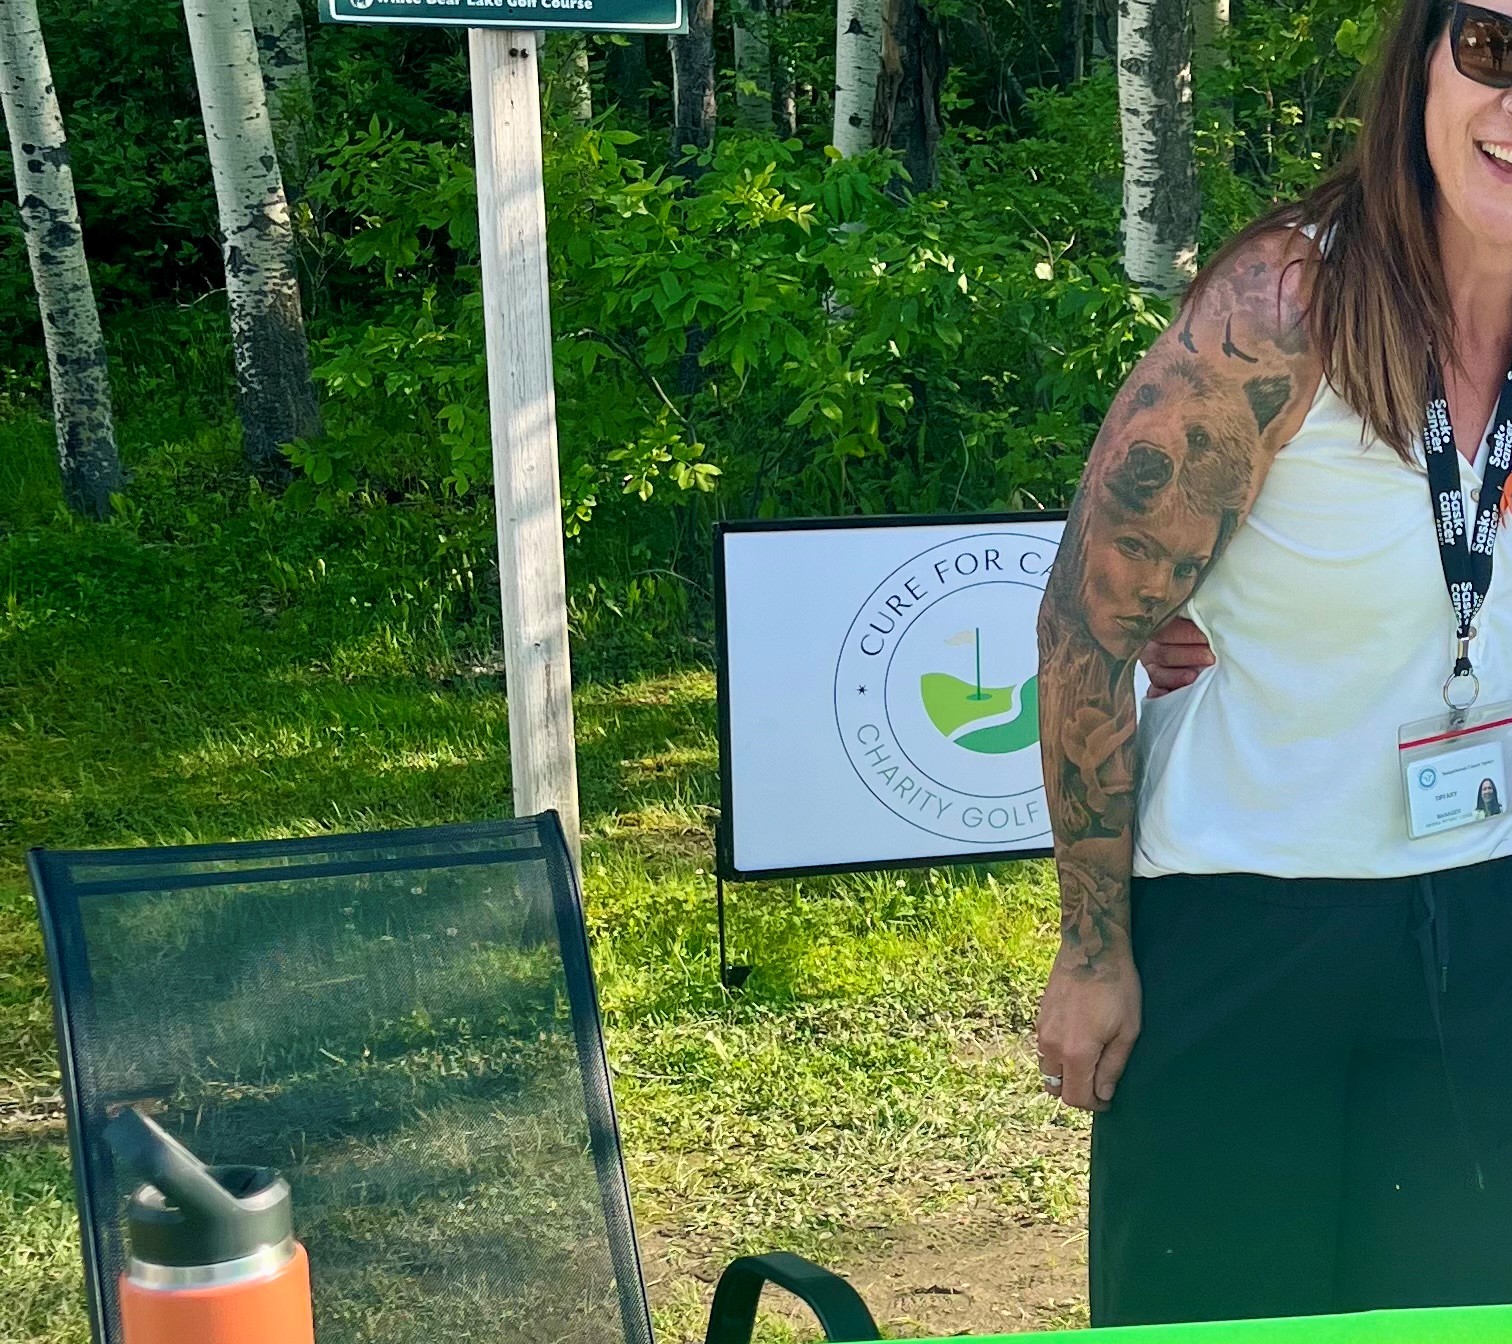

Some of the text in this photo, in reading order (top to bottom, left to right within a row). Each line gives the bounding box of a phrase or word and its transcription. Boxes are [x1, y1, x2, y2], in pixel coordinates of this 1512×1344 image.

[1434, 399, 1453, 435] Sask
[1489, 429, 1507, 468] Sask
[1439, 491, 1456, 546] cancer
[1449, 490, 1465, 529] Sask
[1471, 516, 1491, 554] Sask
[860, 576, 928, 657] CURE
[934, 549, 1004, 584] FOR
[857, 723, 1040, 829] CHARITY GOLF
